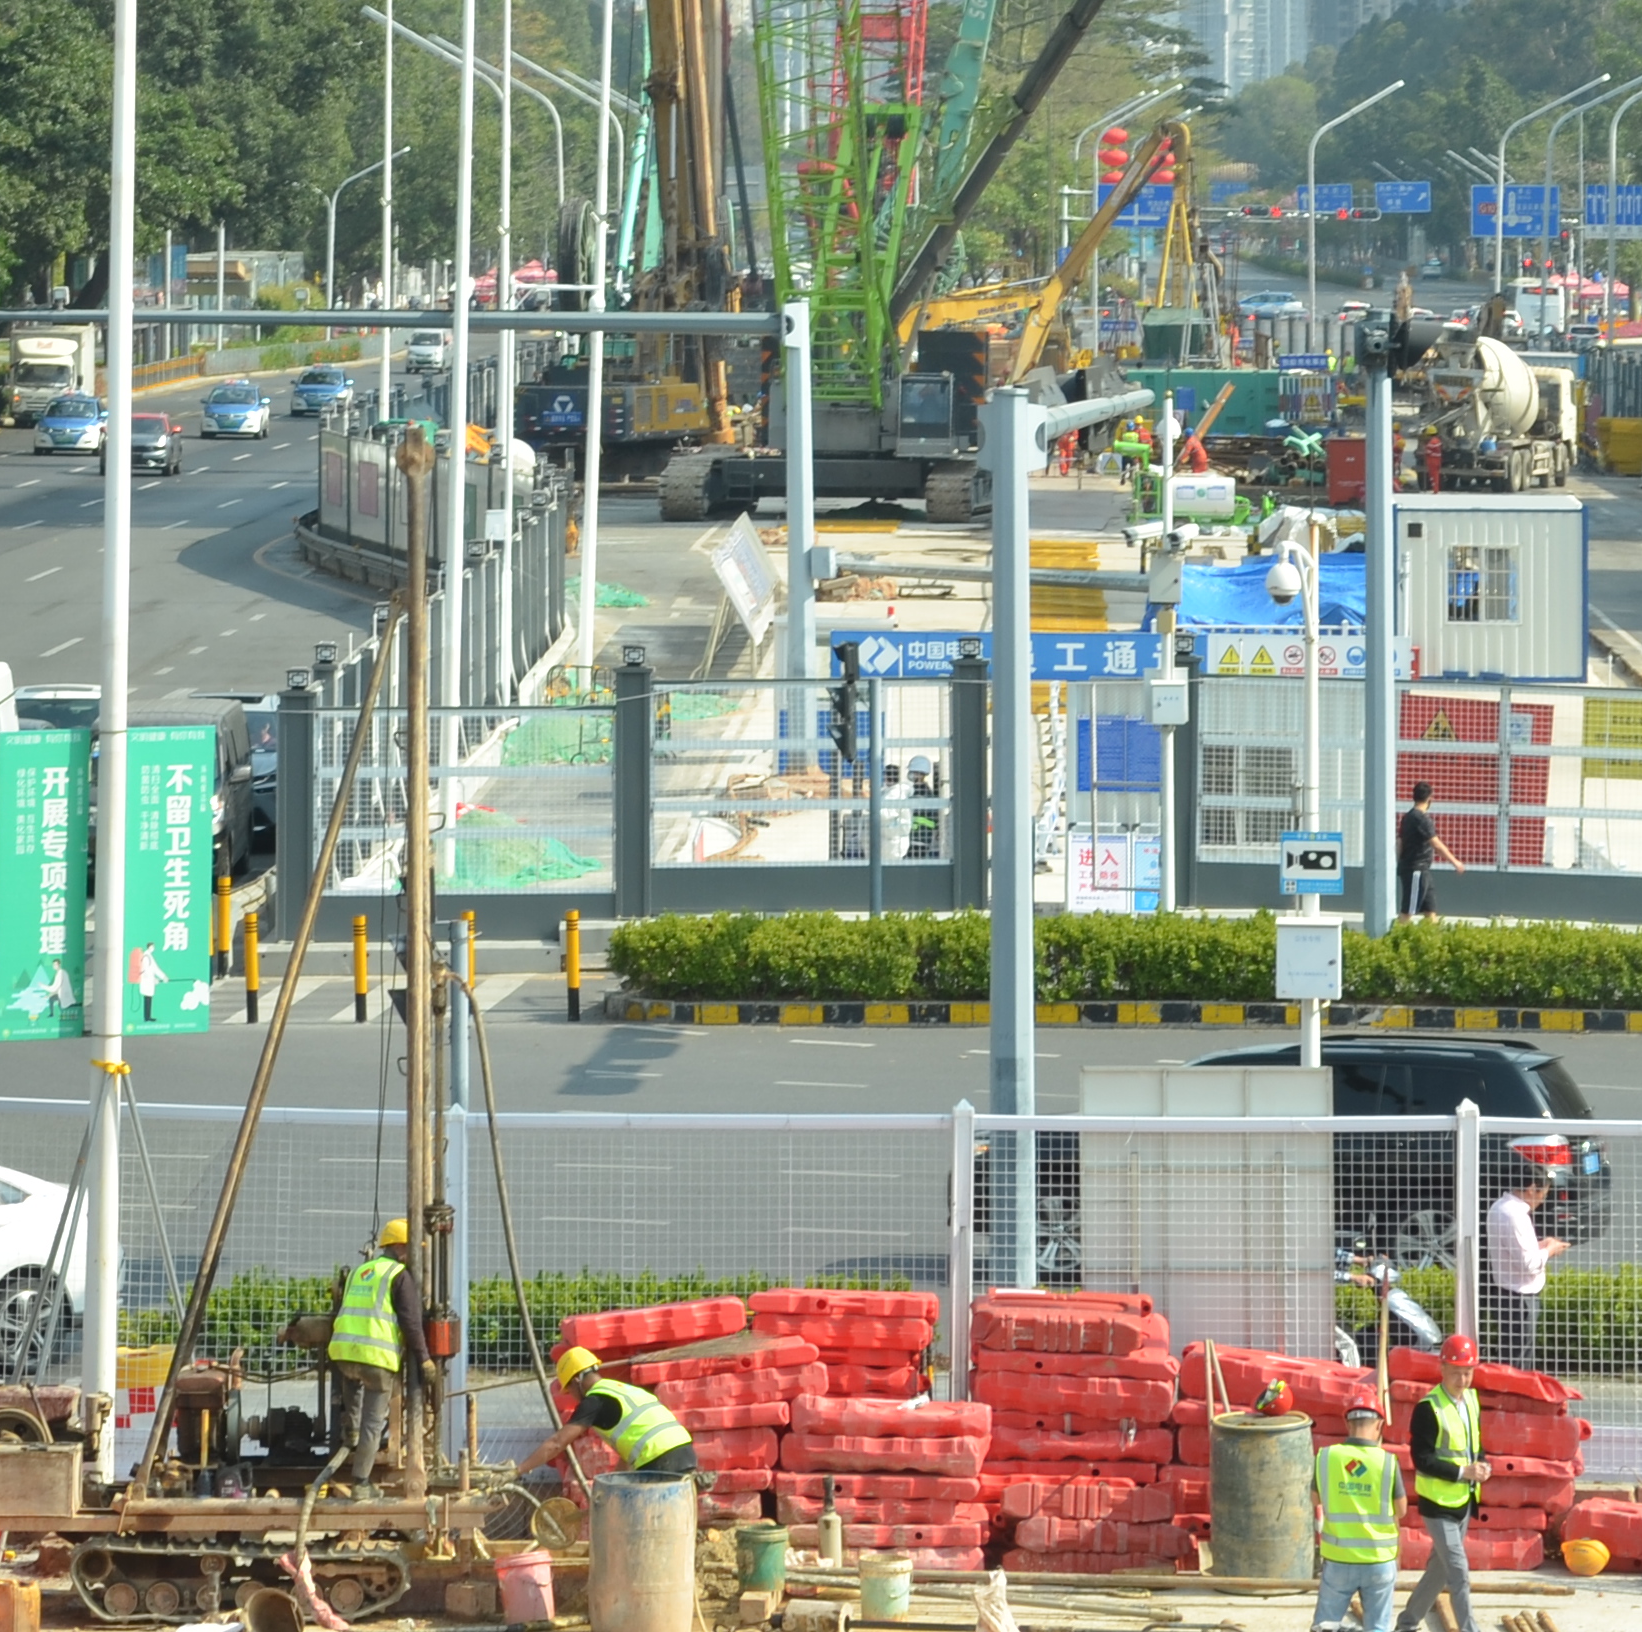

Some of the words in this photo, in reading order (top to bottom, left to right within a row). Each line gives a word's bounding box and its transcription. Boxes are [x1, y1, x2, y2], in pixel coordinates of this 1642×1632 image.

[38, 766, 69, 956] 开展专项治理
[162, 764, 194, 952] 不留卫生死角
